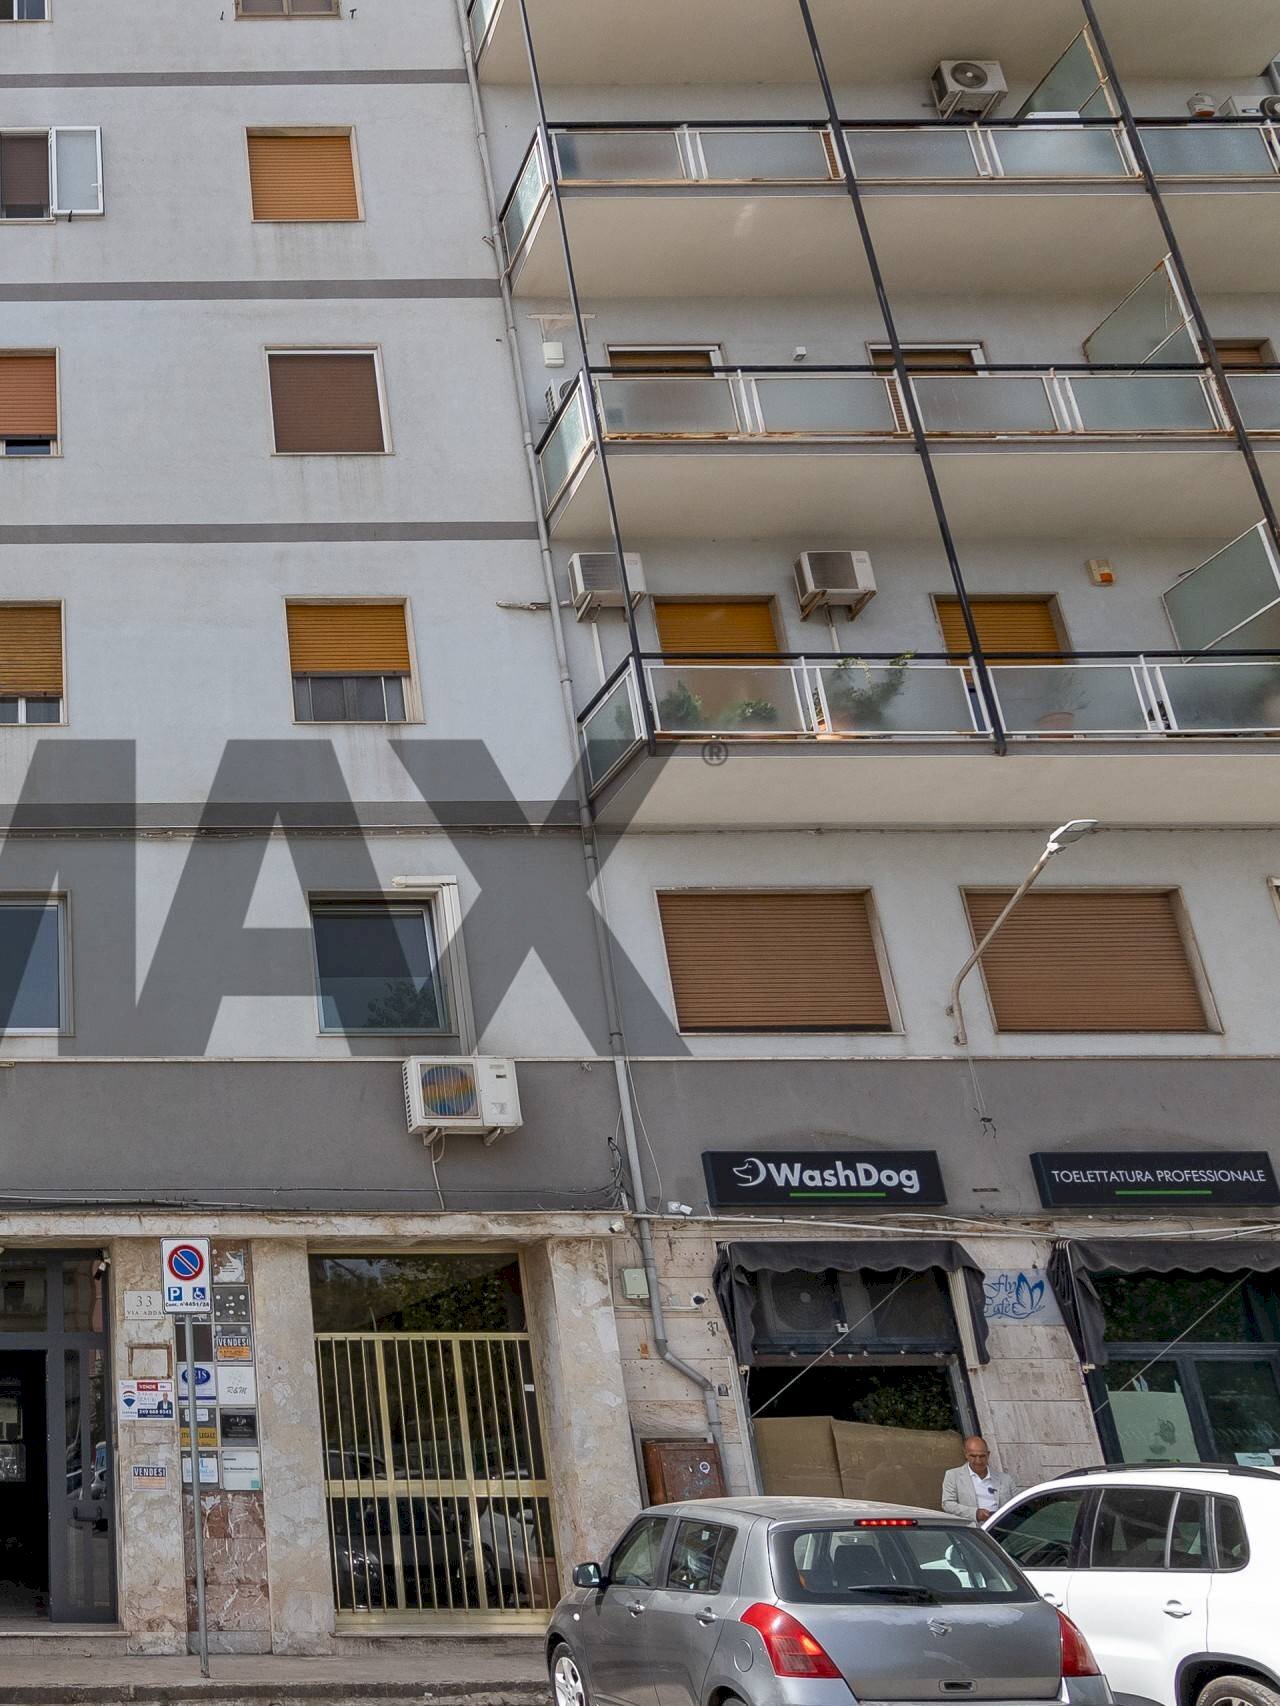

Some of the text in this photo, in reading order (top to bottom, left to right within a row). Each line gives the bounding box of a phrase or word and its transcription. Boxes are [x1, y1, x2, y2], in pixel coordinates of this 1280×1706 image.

[767, 1160, 921, 1194] WashDog
[1051, 1169, 1267, 1183] TOELETTATURA PROFESSIONALE
[136, 1296, 152, 1307] 33
[218, 1337, 249, 1347] VENDESI
[134, 1467, 166, 1476] VENDESI
